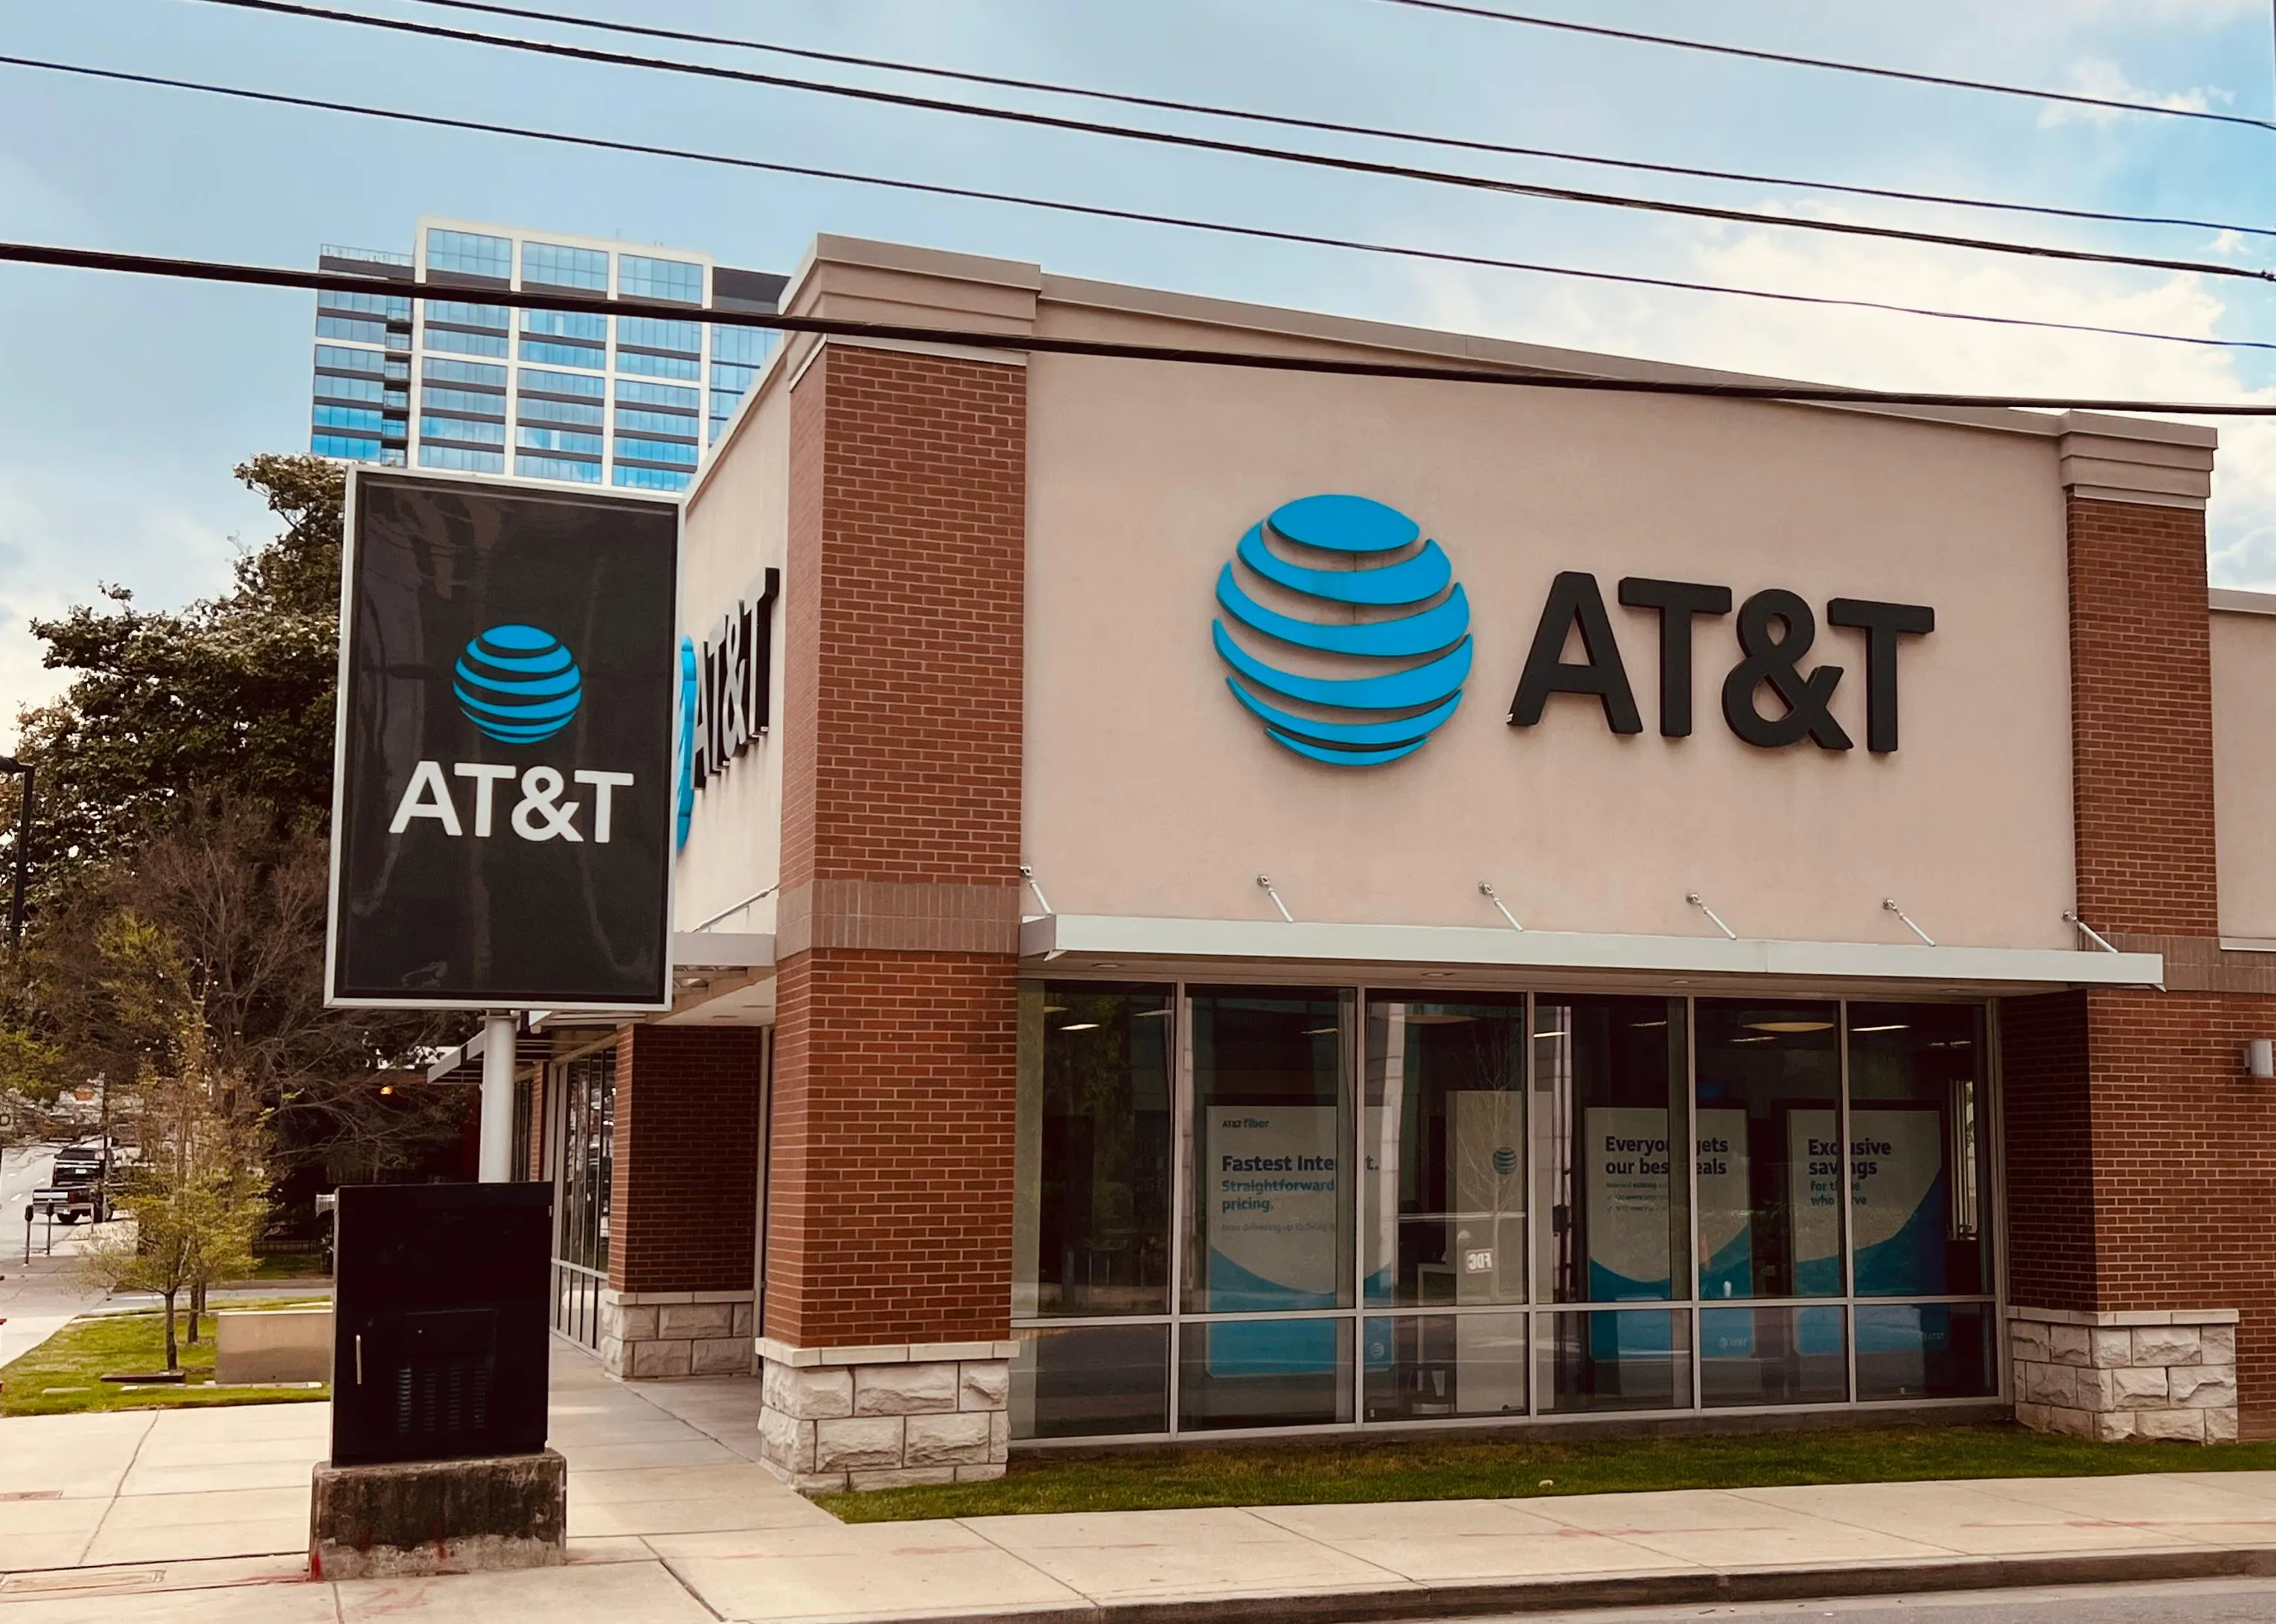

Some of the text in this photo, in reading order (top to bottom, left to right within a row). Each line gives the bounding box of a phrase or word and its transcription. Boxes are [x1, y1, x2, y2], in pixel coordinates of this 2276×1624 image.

[1506, 571, 1934, 752] AT&T
[691, 567, 779, 790] AT&T
[389, 761, 634, 843] AT&T
[1221, 1118, 1270, 1128] AT&T fiber
[1605, 1136, 1669, 1157] Everyo
[1221, 1155, 1379, 1172] Fastest Intet.
[1605, 1157, 1727, 1174] our bes eals
[1221, 1179, 1334, 1195] Straightforward
[1810, 1180, 1827, 1192] for
[1221, 1198, 1273, 1213] pricing.
[1810, 1194, 1835, 1206] who
